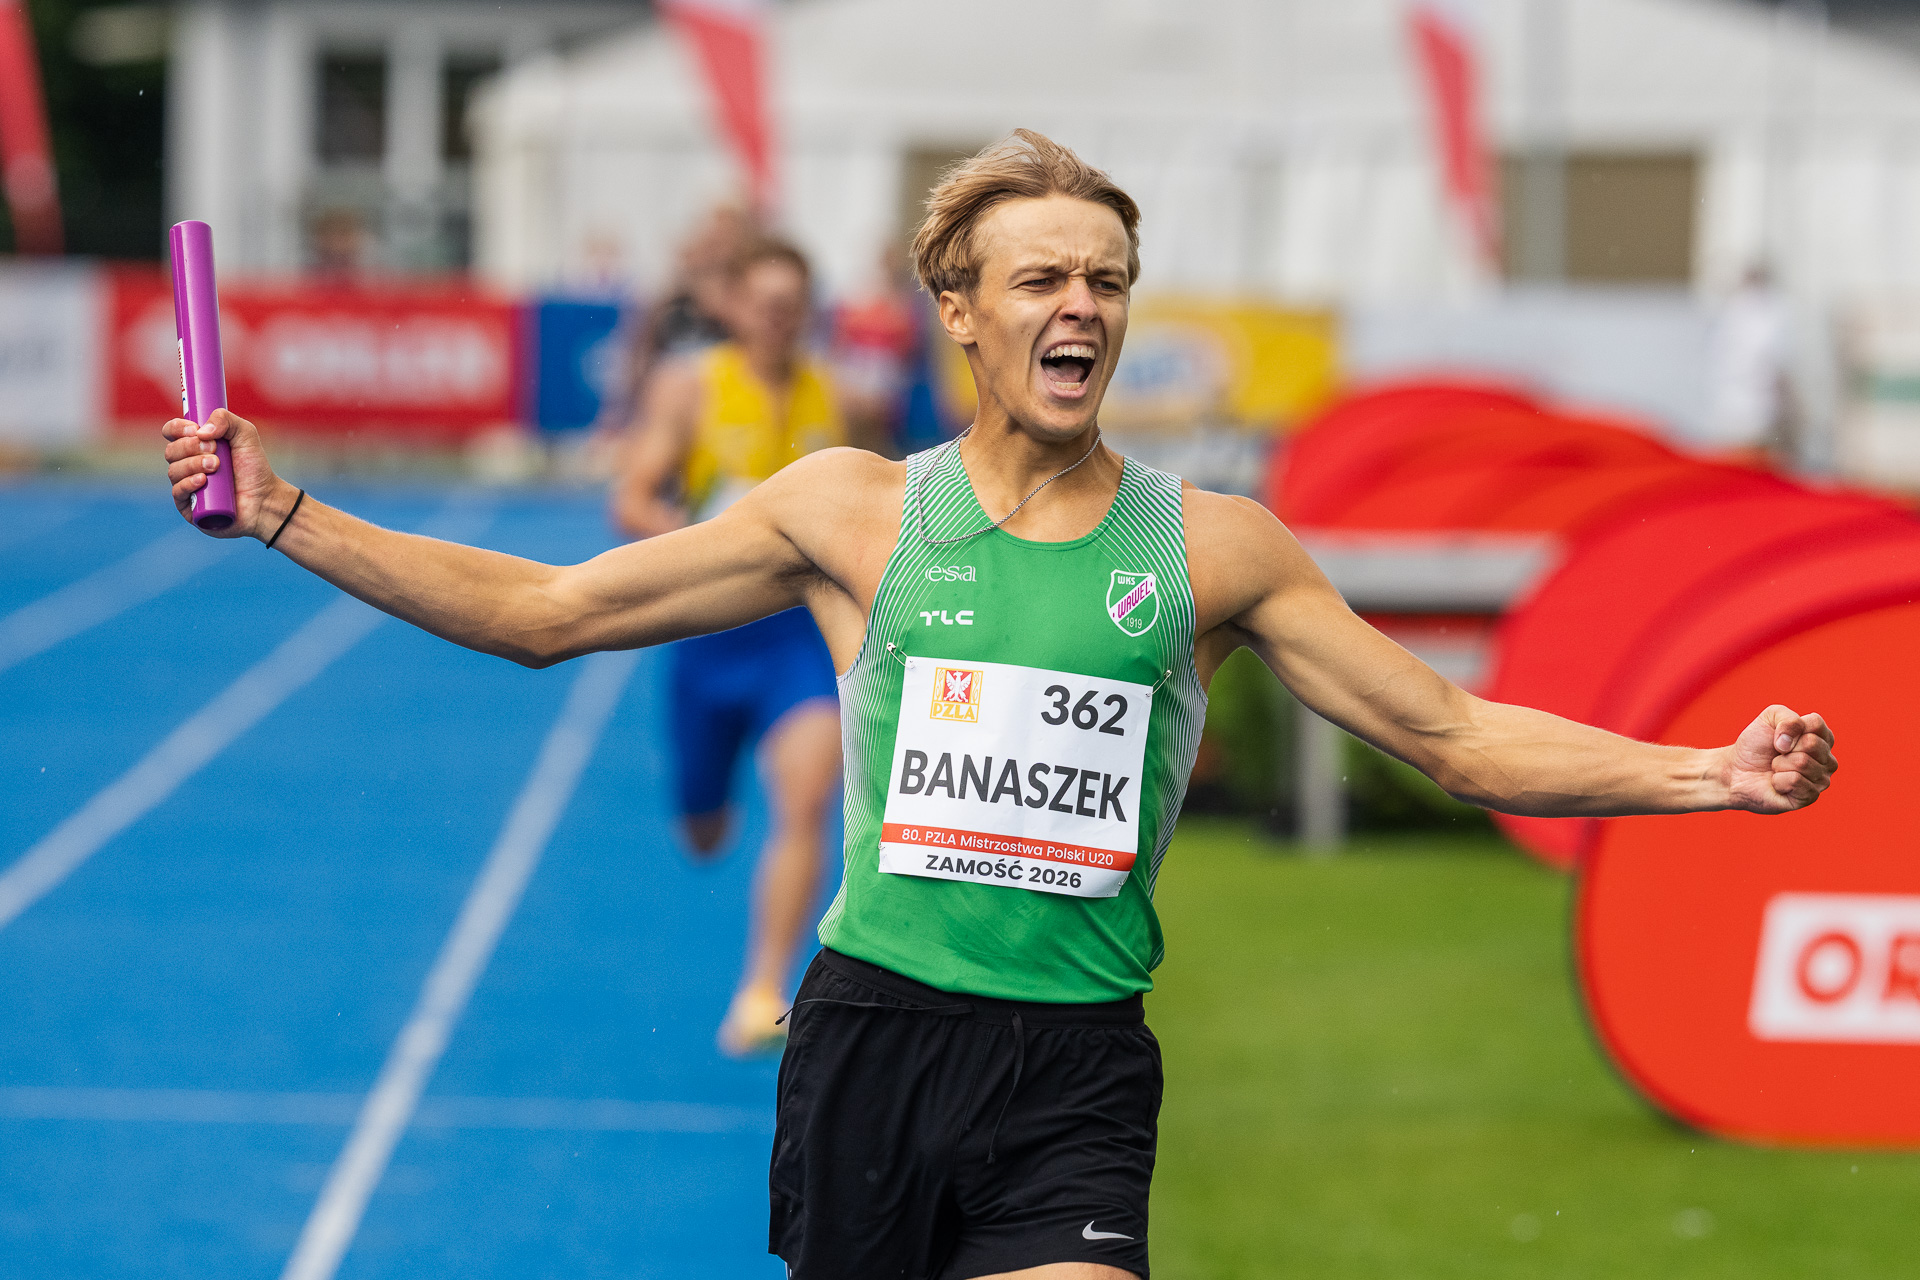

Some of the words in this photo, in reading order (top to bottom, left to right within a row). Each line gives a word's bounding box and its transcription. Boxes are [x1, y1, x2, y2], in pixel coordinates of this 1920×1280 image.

[1117, 575, 1136, 586] WKS
[1117, 580, 1151, 619] WAWEL
[919, 610, 974, 626] TLC
[1126, 617, 1143, 629] 1919
[932, 702, 976, 720] PZLA
[1040, 684, 1129, 737] 362
[899, 749, 1130, 823] BANASZEK
[901, 828, 922, 842] 80.
[925, 831, 957, 846] PZLA
[960, 835, 1043, 856] Mistrzostwa
[1046, 848, 1086, 863] Polski
[1088, 853, 1114, 866] U20
[925, 854, 1024, 881] ZAMOŚĆ
[1028, 866, 1083, 889] 2026
